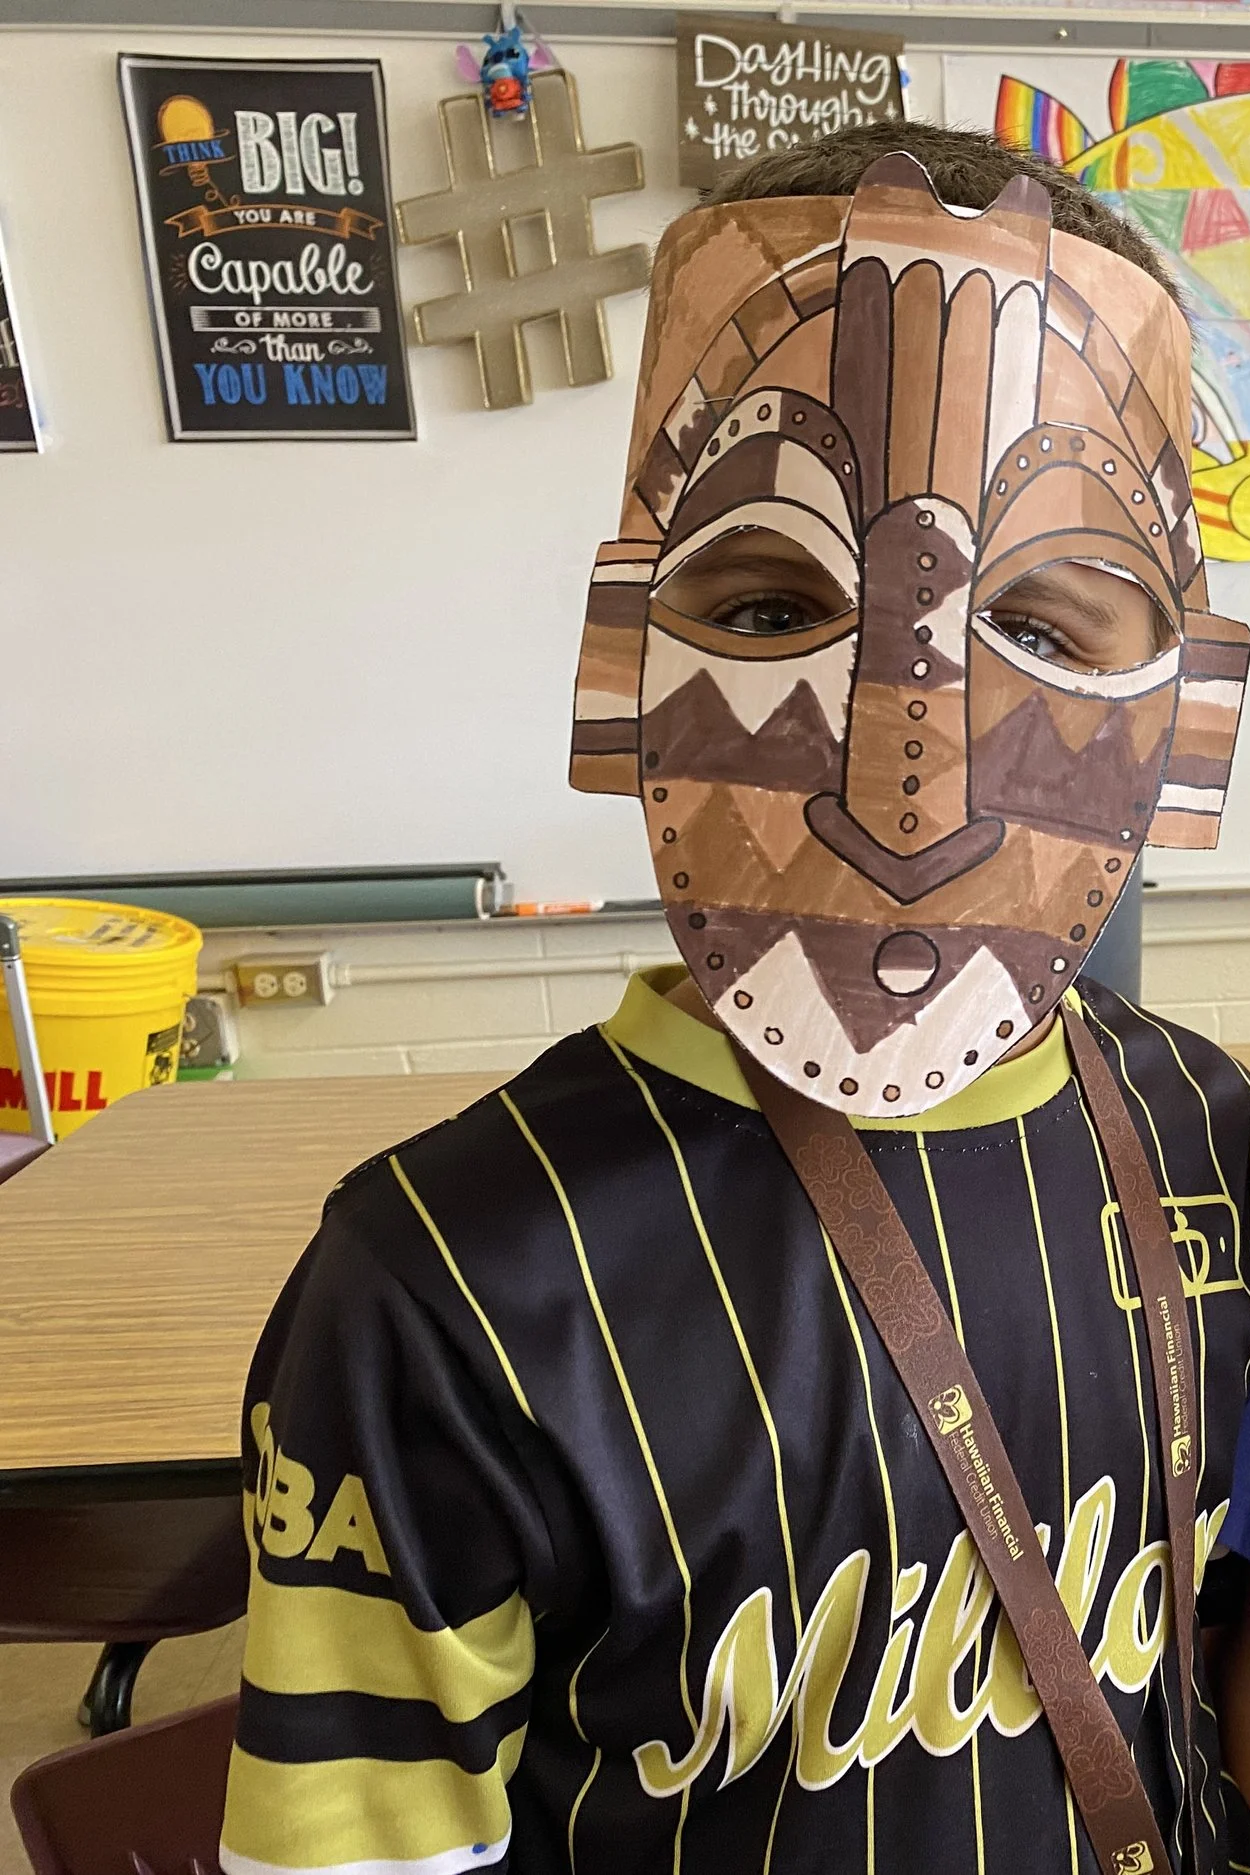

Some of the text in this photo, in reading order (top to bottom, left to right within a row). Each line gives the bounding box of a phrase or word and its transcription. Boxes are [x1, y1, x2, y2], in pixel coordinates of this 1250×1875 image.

[162, 110, 364, 196] THINK BIG!
[703, 121, 761, 160] the
[234, 210, 316, 226] YOU ARE
[187, 241, 375, 305] Capable
[235, 311, 334, 328] OF MORE
[259, 333, 326, 362] than
[193, 363, 388, 405] YOU KNOW
[1173, 1323, 1183, 1359] Union
[1157, 1295, 1181, 1437] Hawaiian Financial
[1177, 1394, 1189, 1435] Federal
[948, 1430, 999, 1541] Federal Credit Union
[959, 1422, 1024, 1562] Hawaiian Financial
